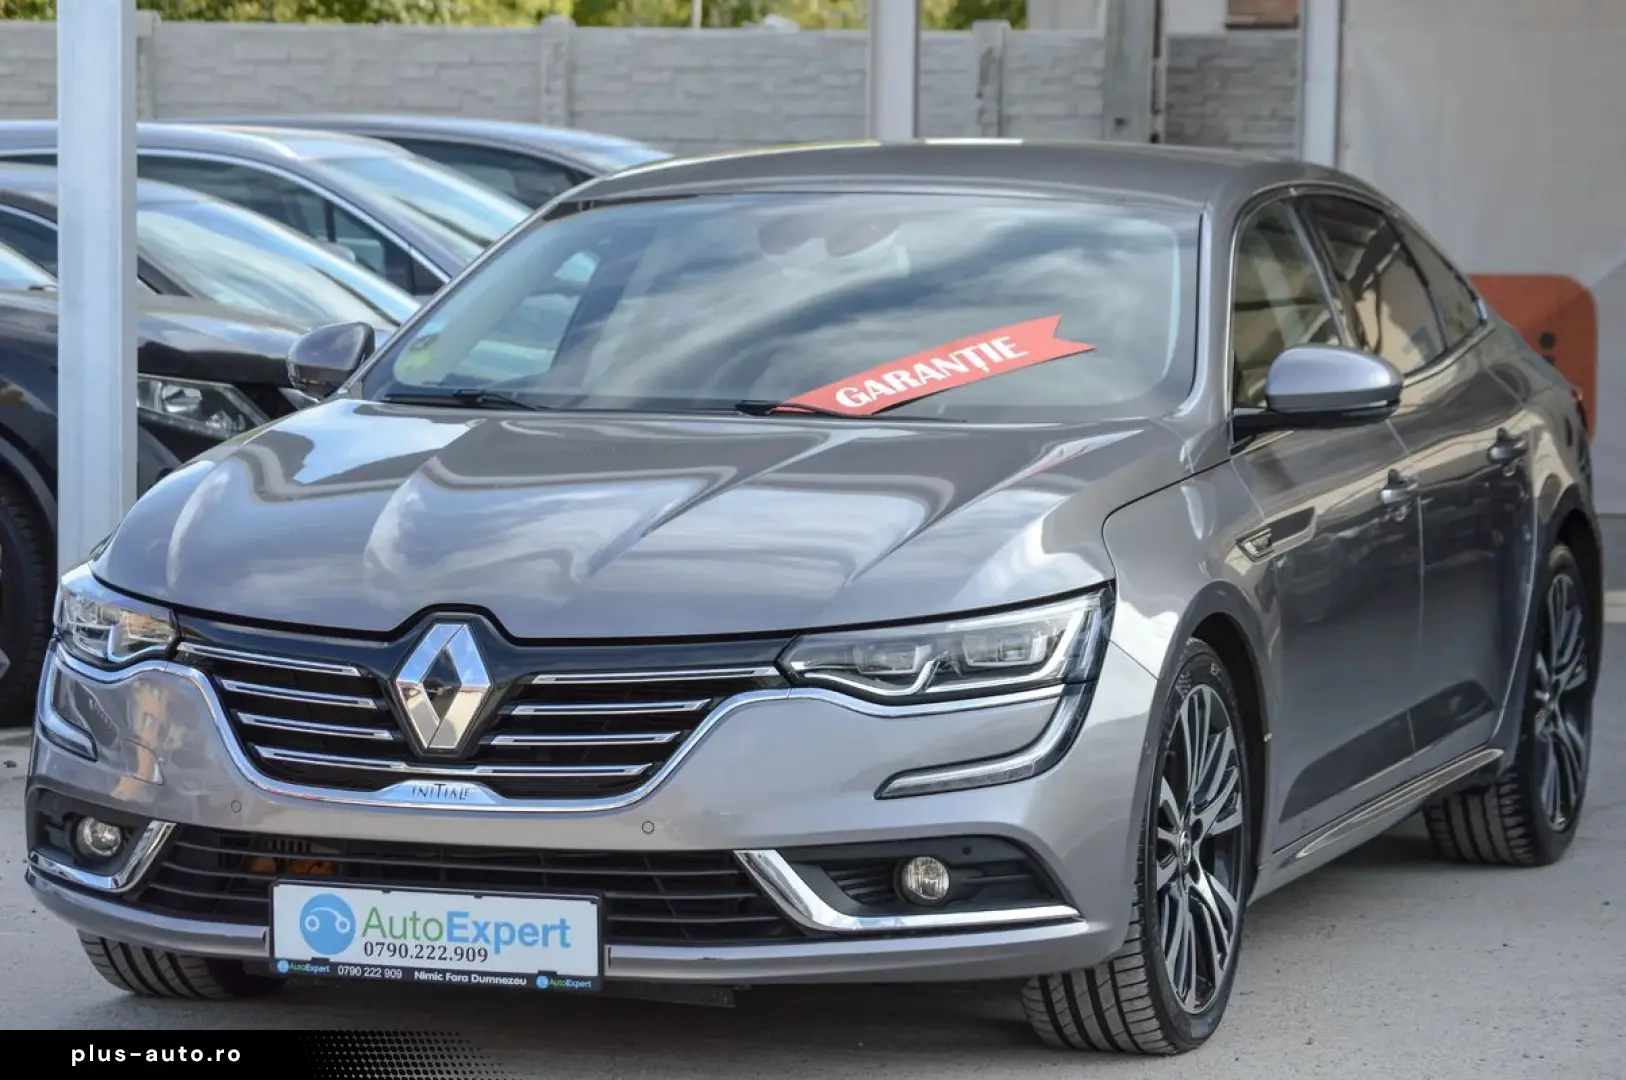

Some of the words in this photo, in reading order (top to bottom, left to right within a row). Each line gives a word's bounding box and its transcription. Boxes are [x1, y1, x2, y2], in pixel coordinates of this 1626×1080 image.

[362, 906, 571, 955] AutoExpert
[364, 941, 488, 963] 0790.222.909
[290, 962, 331, 974] AutoExpert
[337, 965, 361, 977] 0790
[364, 967, 382, 977] 222
[384, 968, 402, 979] 909
[414, 970, 443, 981] Nimic
[445, 972, 469, 983] Fara
[471, 974, 527, 986] Dumnezeu
[549, 977, 592, 989] AutoExpert
